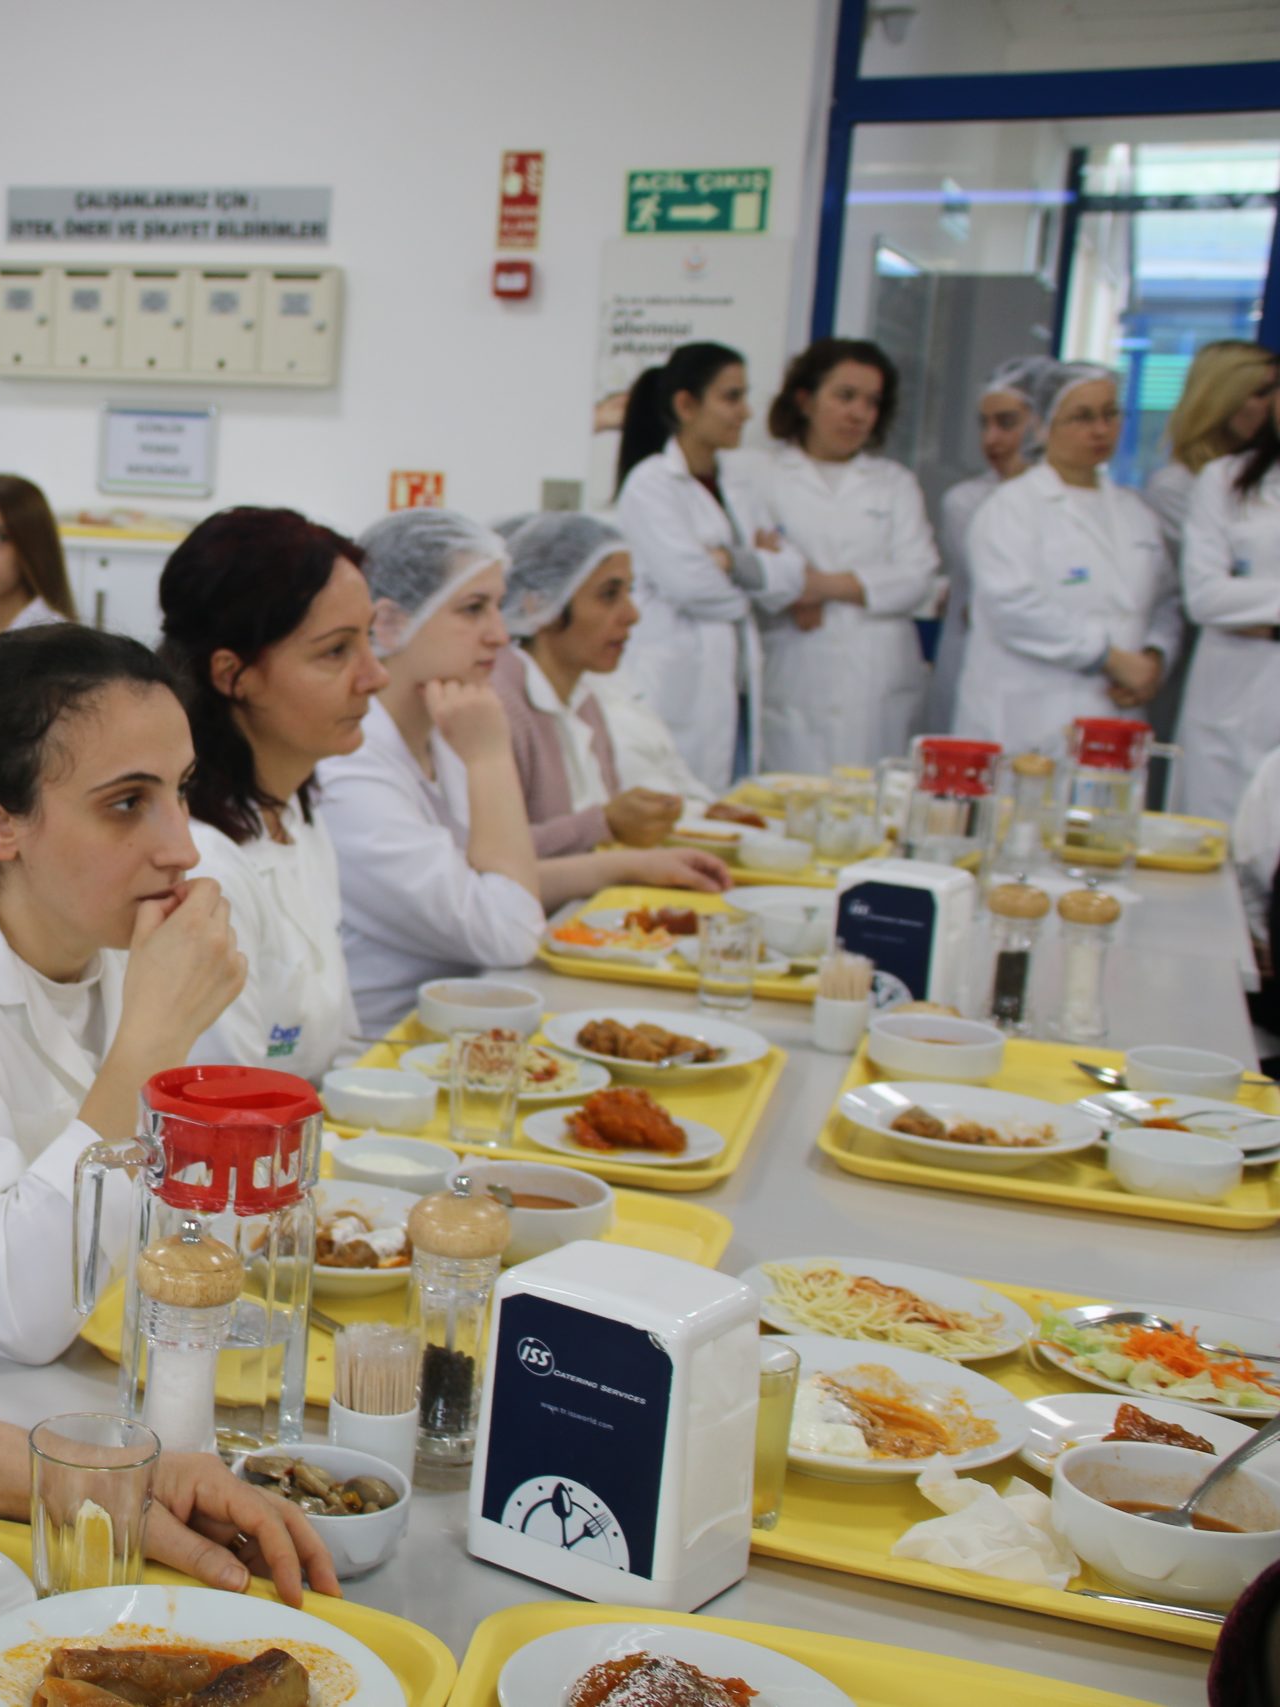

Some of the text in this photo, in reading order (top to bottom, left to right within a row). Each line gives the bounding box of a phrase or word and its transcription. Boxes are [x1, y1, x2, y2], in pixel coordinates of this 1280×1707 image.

[119, 219, 137, 236] VE
[553, 1369, 598, 1389] CATERING
[600, 1384, 647, 1405] SERVICES
